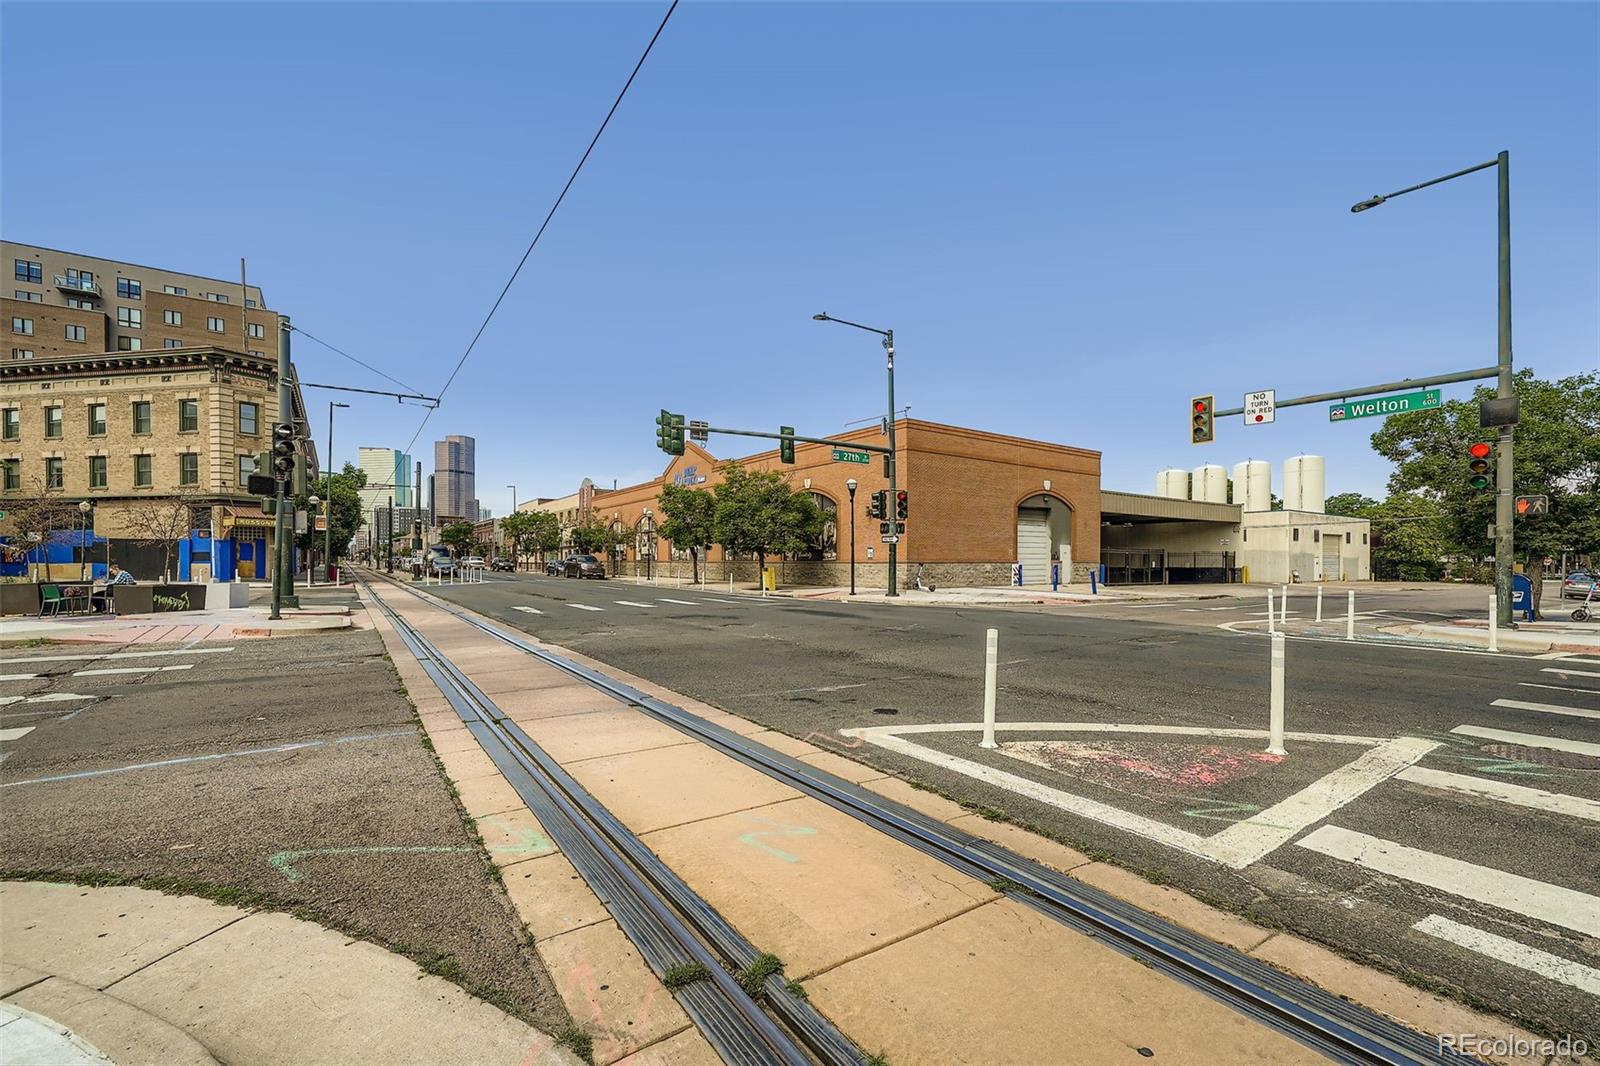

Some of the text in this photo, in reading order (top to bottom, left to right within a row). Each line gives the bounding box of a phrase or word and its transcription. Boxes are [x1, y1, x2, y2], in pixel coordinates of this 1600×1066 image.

[1253, 392, 1266, 400] NO
[1250, 400, 1269, 408] TURN
[1351, 399, 1409, 416] Welton
[843, 452, 860, 462] 27th
